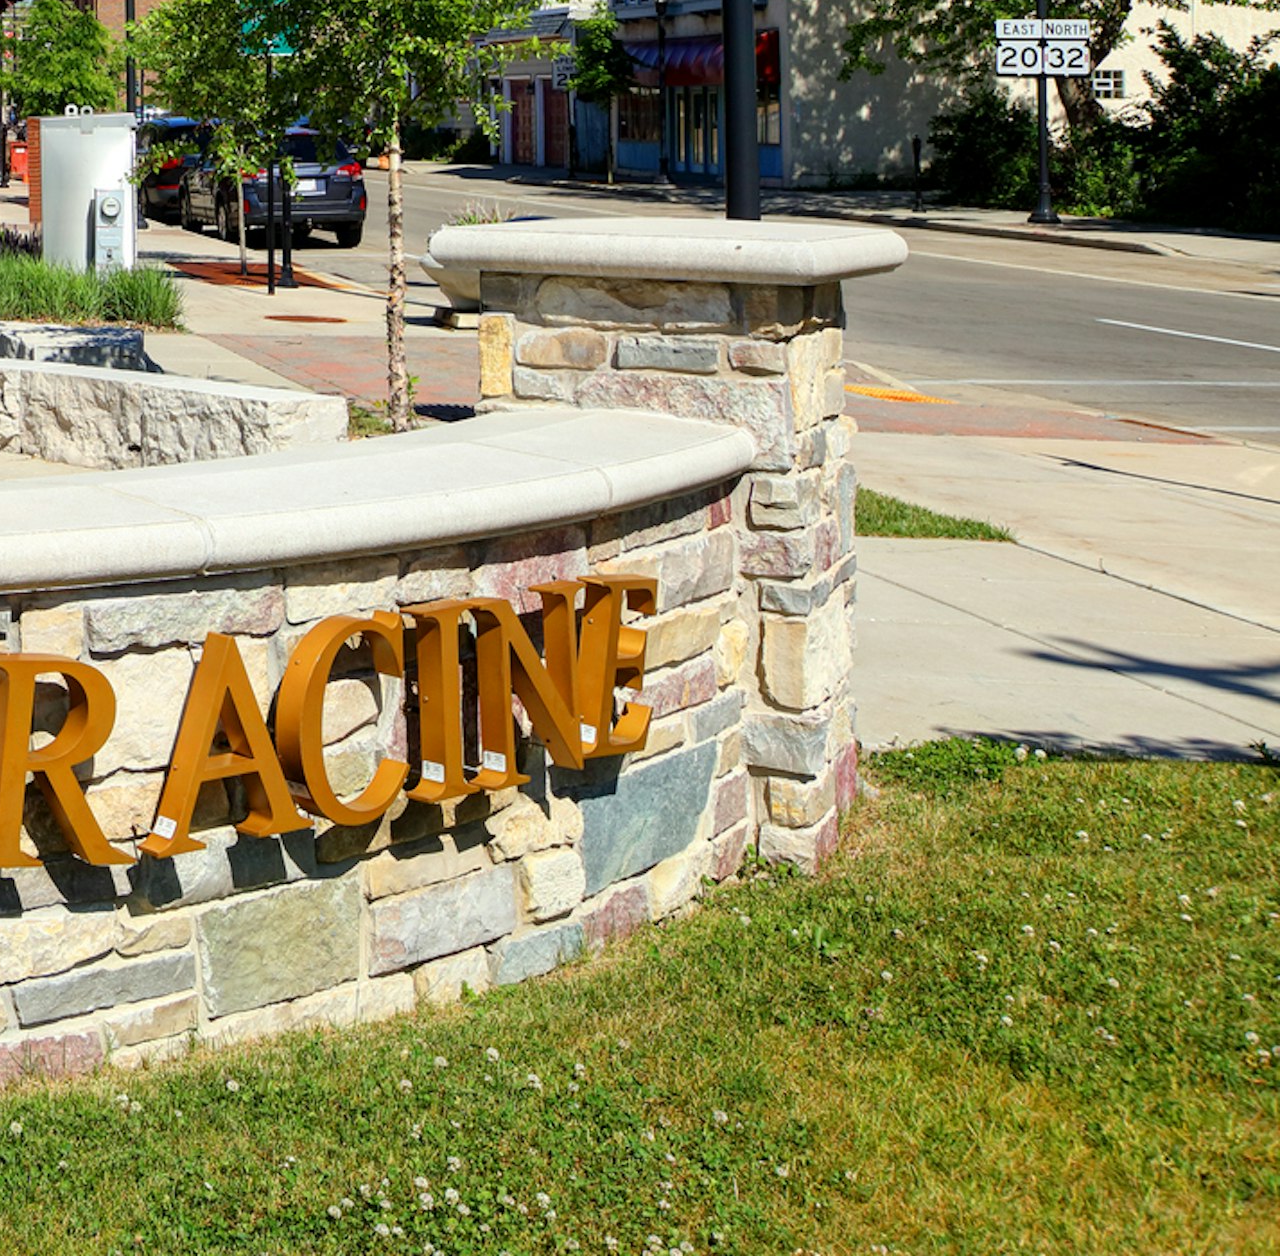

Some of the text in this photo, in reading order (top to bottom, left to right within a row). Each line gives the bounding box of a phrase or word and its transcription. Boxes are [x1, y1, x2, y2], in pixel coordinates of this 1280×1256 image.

[1003, 23, 1035, 35] EAST
[1045, 23, 1087, 35] NORTH
[1001, 47, 1038, 68] 20
[1049, 48, 1083, 68] 32
